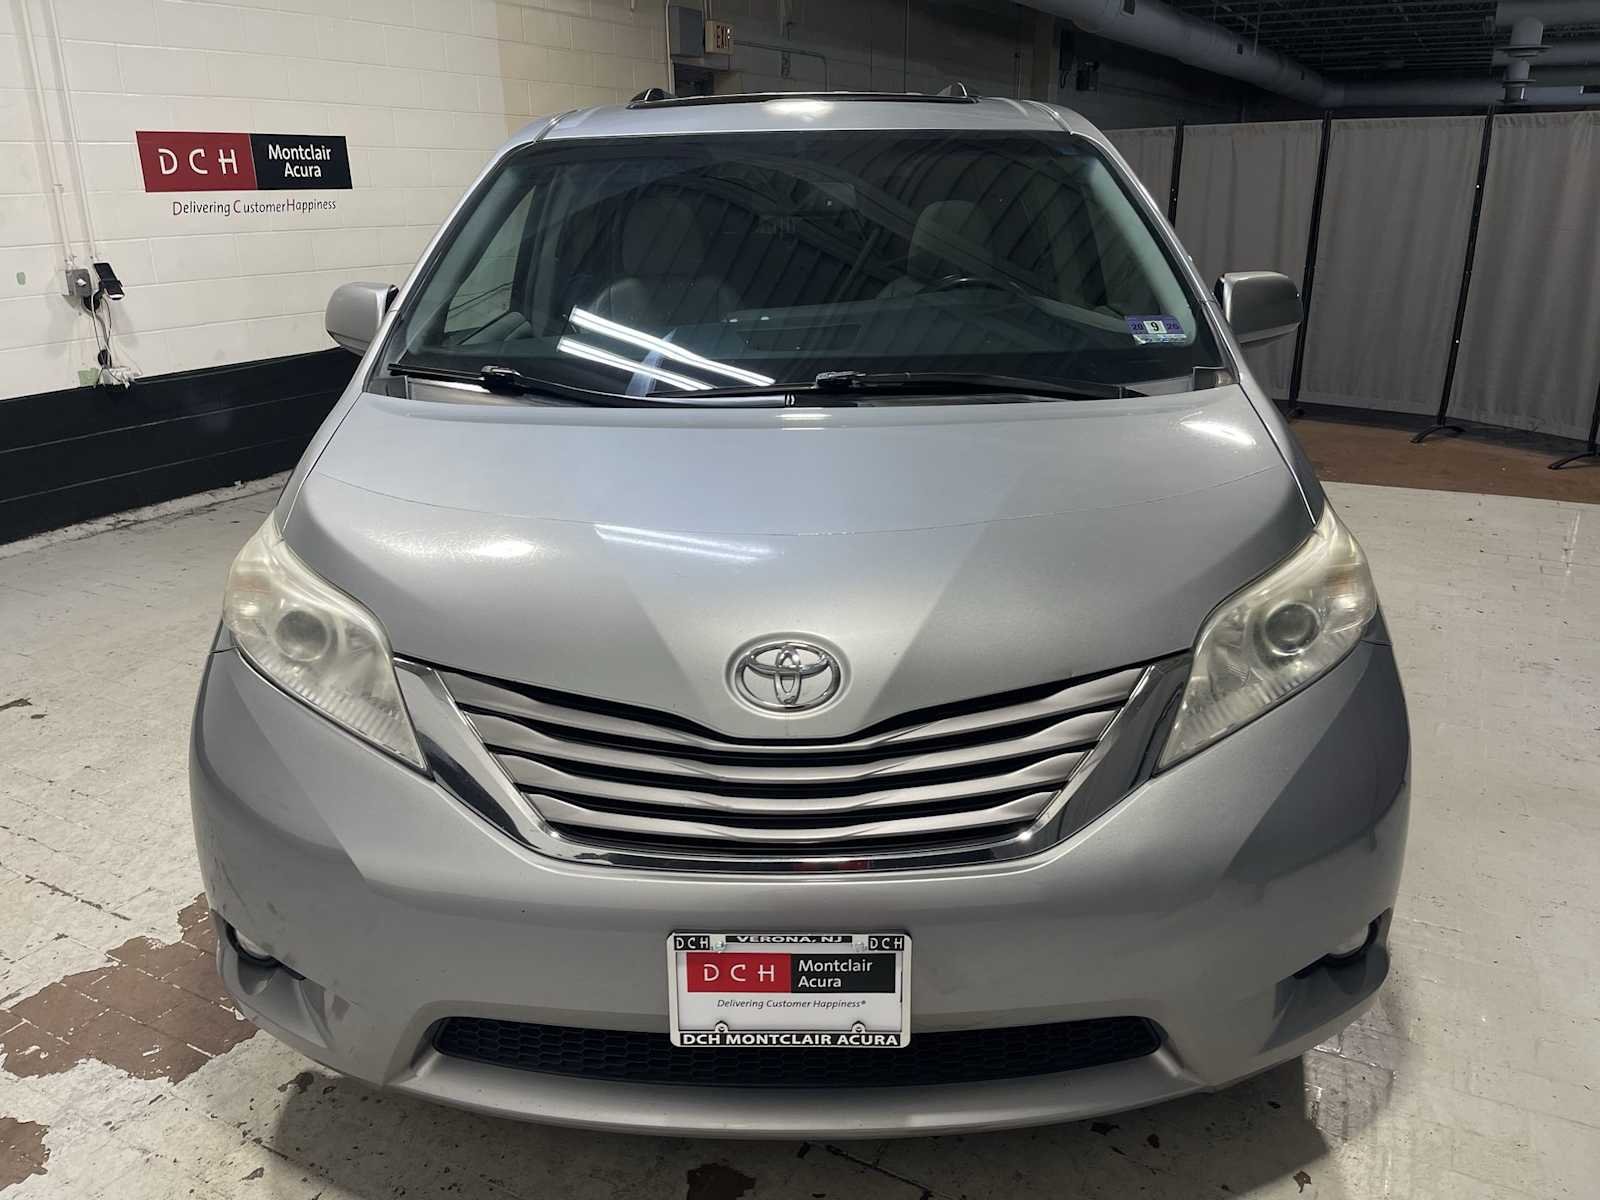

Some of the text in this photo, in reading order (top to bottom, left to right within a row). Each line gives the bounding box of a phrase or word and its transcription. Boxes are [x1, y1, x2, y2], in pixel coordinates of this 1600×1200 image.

[268, 144, 331, 160] Montclair
[284, 163, 322, 178] Acura
[172, 201, 231, 217] Delivering
[1150, 321, 1159, 331] 9
[798, 959, 873, 972] Montclair
[798, 976, 842, 988] Acura
[717, 999, 764, 1009] Delivering
[766, 999, 812, 1008] Customer
[683, 1033, 899, 1046] DCH MONTCLAIR ACURA
